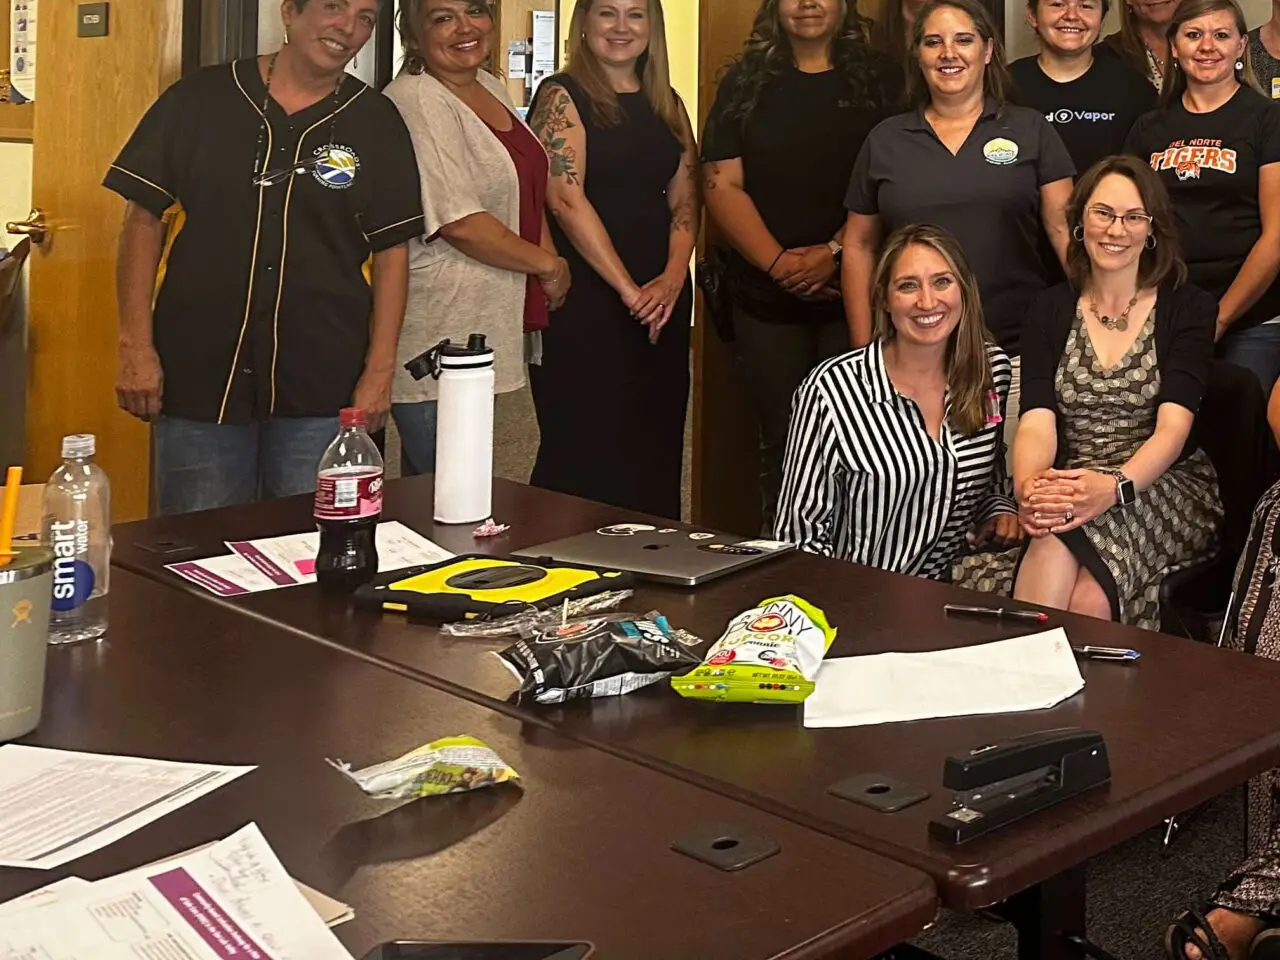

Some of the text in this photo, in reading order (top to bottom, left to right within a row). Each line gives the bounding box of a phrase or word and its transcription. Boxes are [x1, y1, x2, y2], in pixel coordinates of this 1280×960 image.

[1075, 110, 1115, 123] Vapor
[1189, 138, 1222, 147] NORTE
[1151, 146, 1237, 174] TIGERS
[76, 519, 88, 555] water
[51, 520, 75, 599] smart
